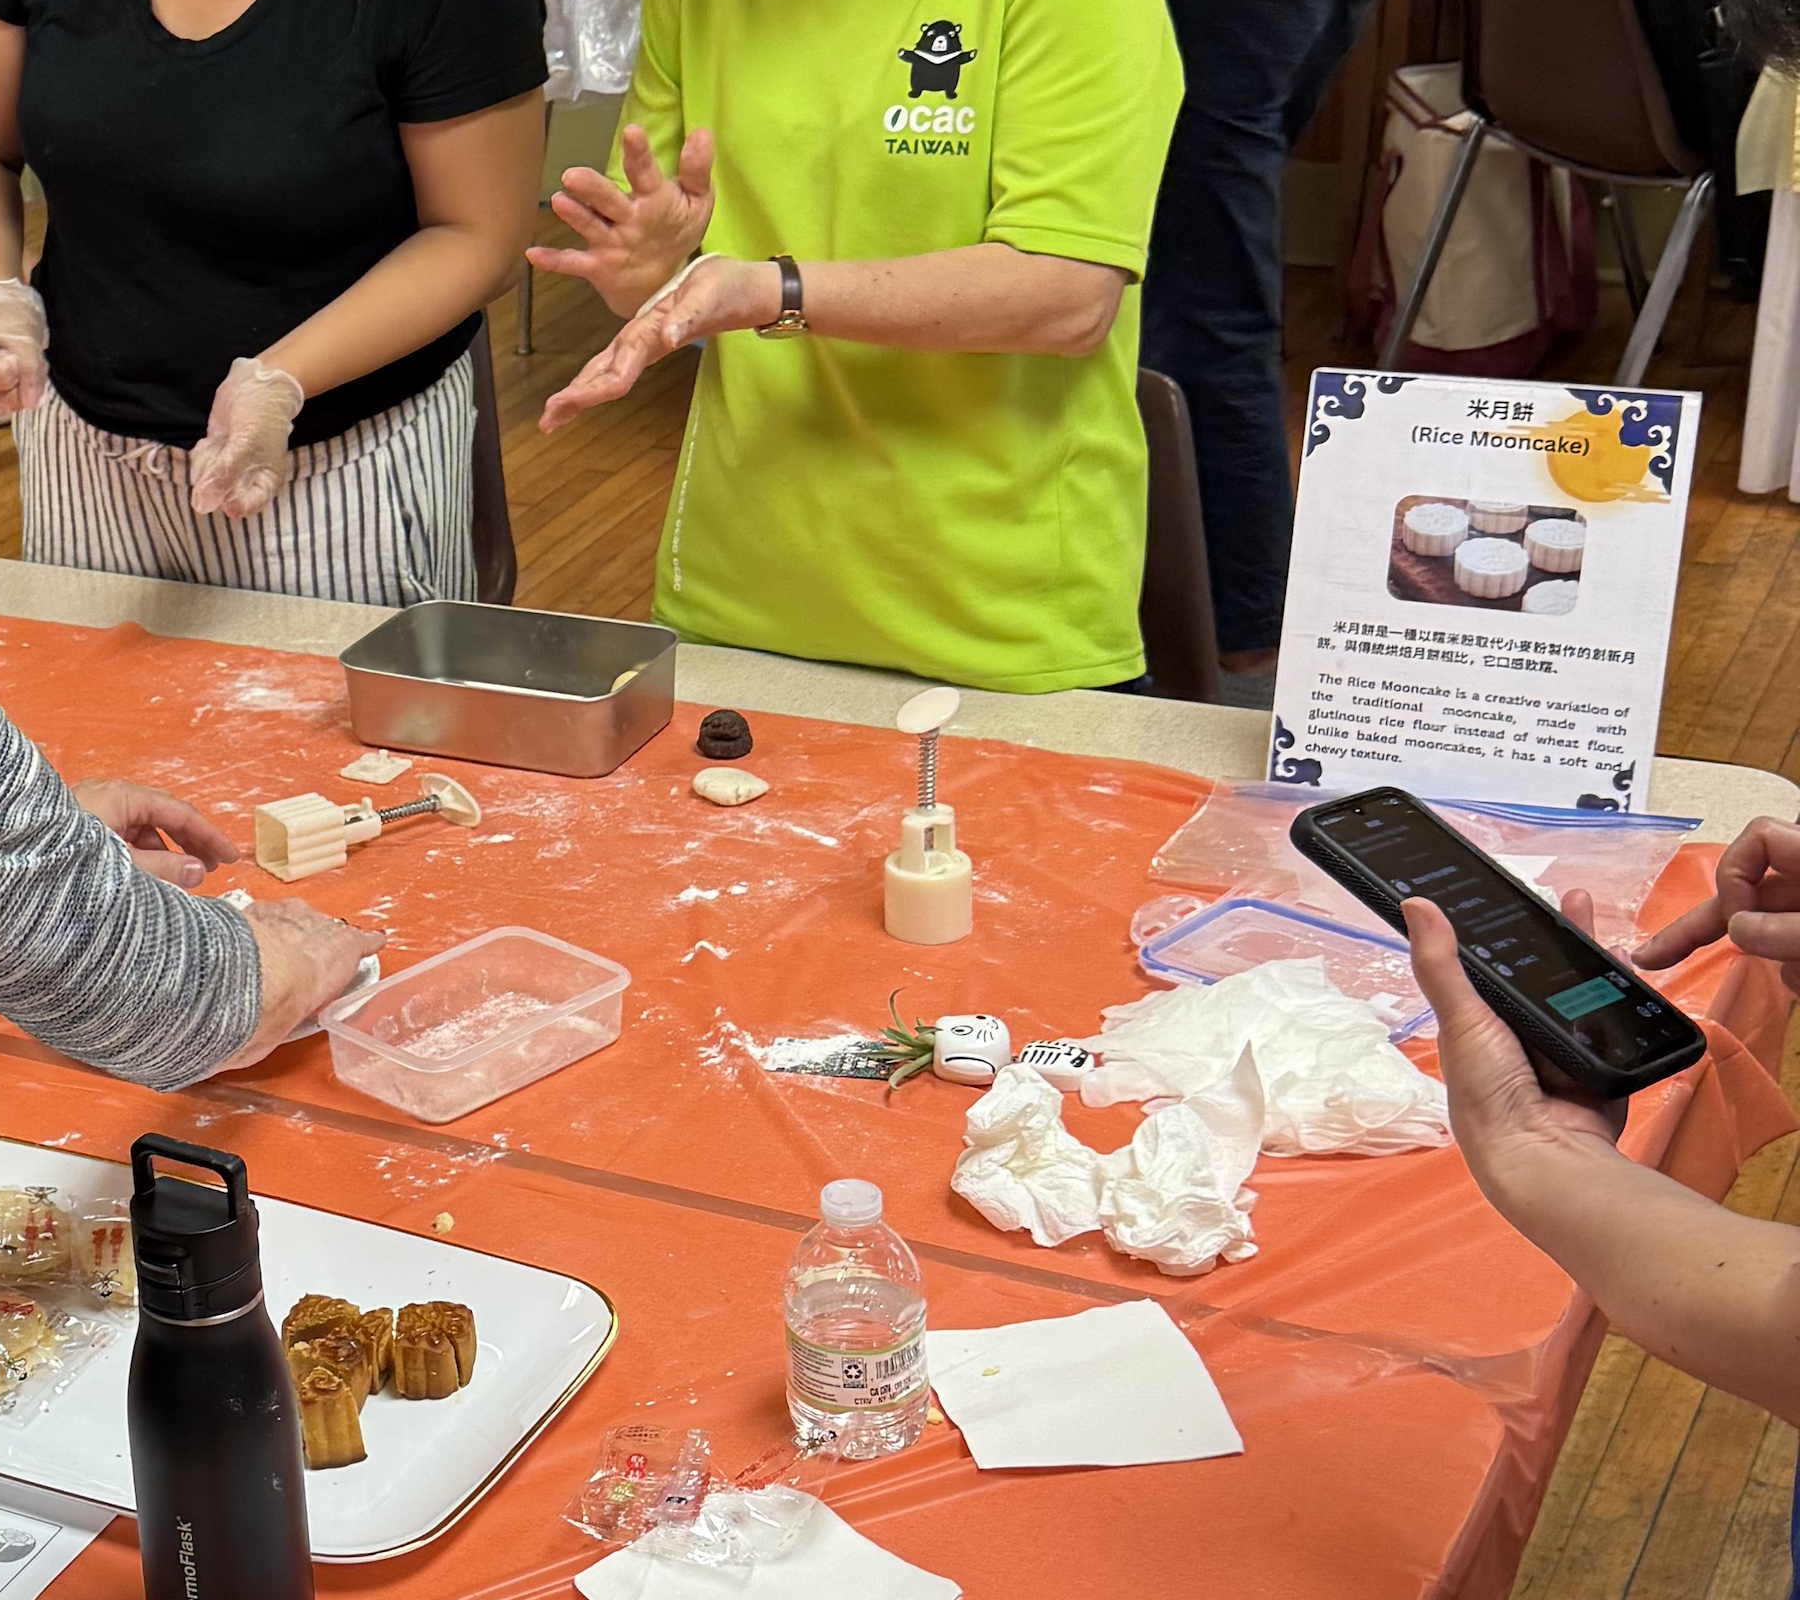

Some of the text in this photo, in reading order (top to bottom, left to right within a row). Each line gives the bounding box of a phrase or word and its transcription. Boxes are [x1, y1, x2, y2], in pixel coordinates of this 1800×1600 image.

[885, 139, 969, 156] TAIWAN
[1466, 399, 1535, 422] 米月餅
[1410, 425, 1590, 457] (Rice Mooncake)
[1311, 690, 1627, 736] the traditional mooncake, made with
[1318, 673, 1630, 718] The Rice Mooncake is a creative variation of
[1307, 725, 1349, 739] Unlike
[1356, 730, 1398, 745] baked
[1404, 737, 1486, 758] mooncakes,
[1493, 746, 1504, 758] it
[1511, 749, 1536, 762] has
[1543, 755, 1551, 764] a
[1559, 756, 1589, 768] soft
[1308, 708, 1371, 724] glutinous
[1378, 716, 1405, 728] rice
[1412, 719, 1448, 732] flour
[1453, 723, 1505, 740] instead
[1513, 732, 1529, 742] of
[1536, 736, 1580, 749] wheat
[1304, 742, 1403, 763] chewy texture.
